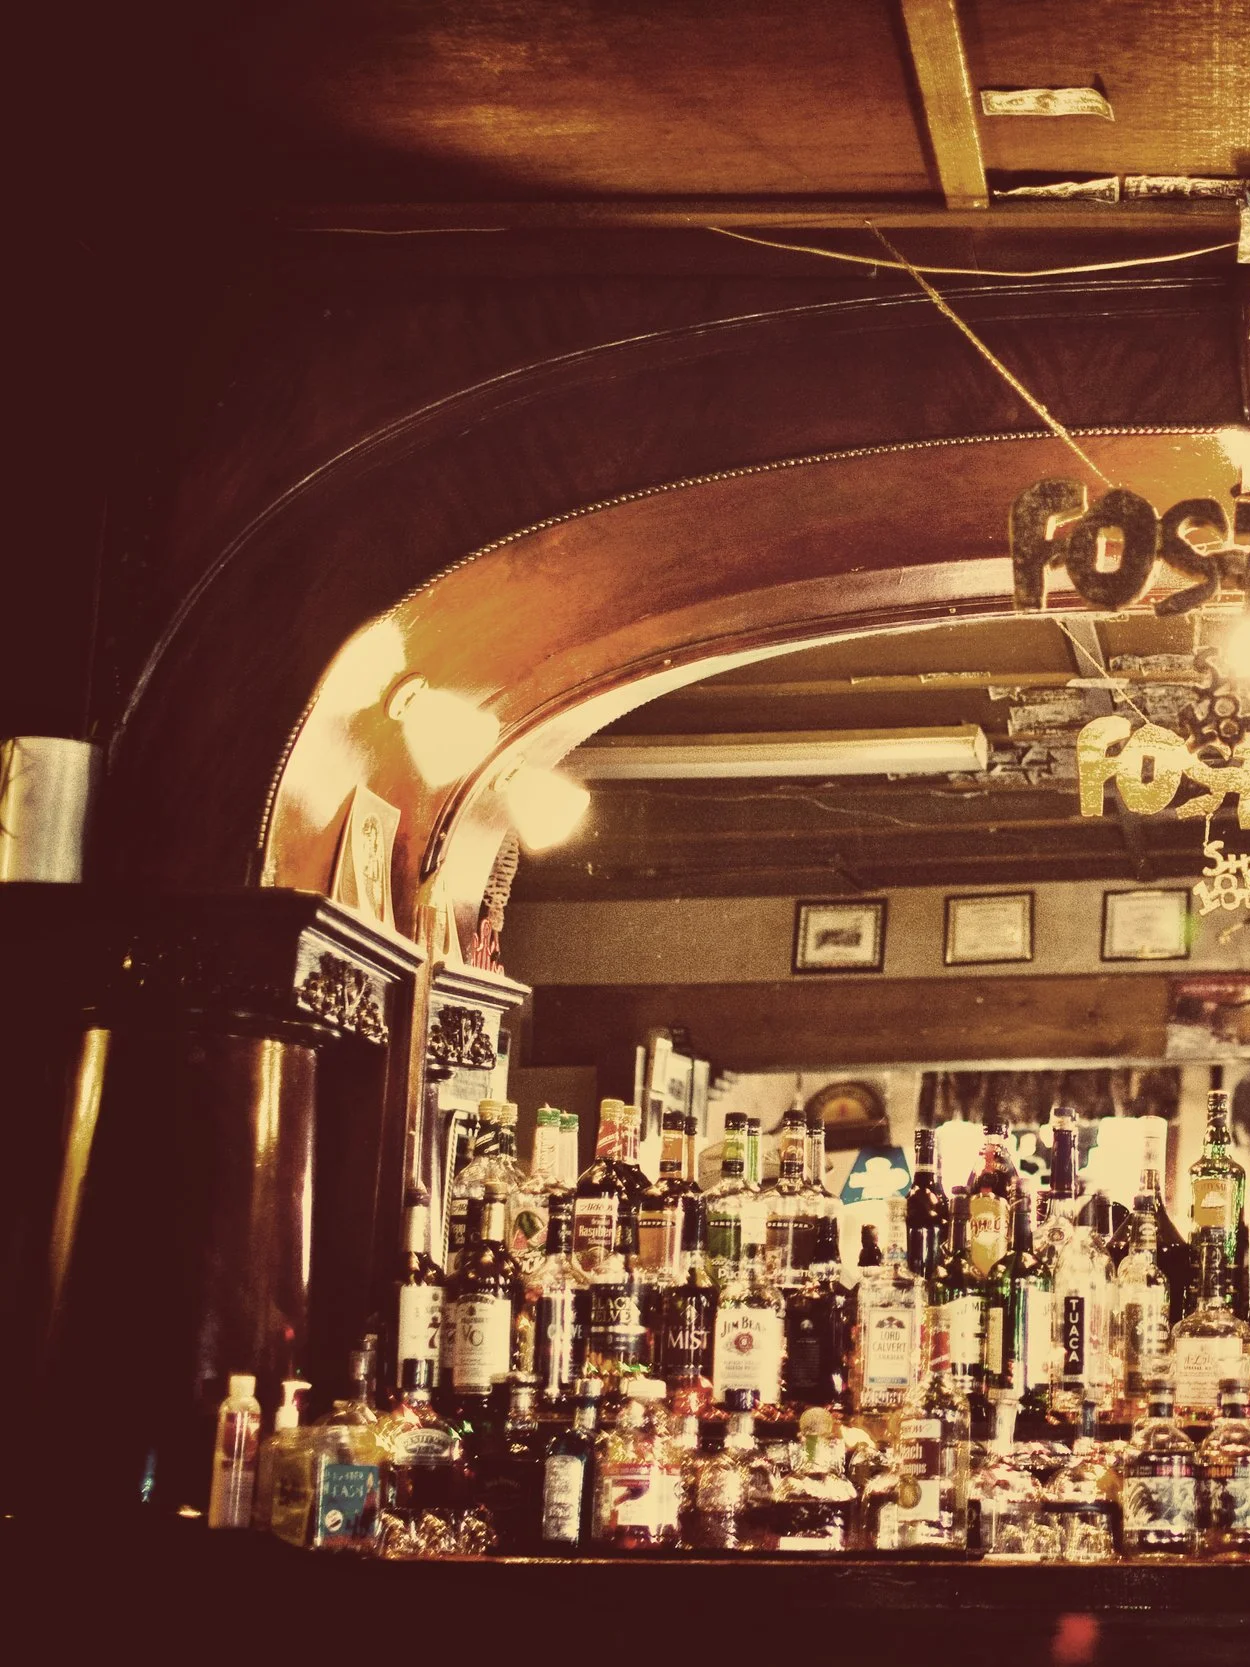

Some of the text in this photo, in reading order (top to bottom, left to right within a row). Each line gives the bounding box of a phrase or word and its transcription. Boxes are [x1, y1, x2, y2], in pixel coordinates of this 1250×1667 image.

[591, 1310, 642, 1323] ELVE
[720, 1320, 739, 1338] JIM
[880, 1330, 900, 1341] LORD
[1068, 1298, 1080, 1363] TUACA
[668, 1330, 711, 1350] MIST
[872, 1342, 907, 1353] CALVERT
